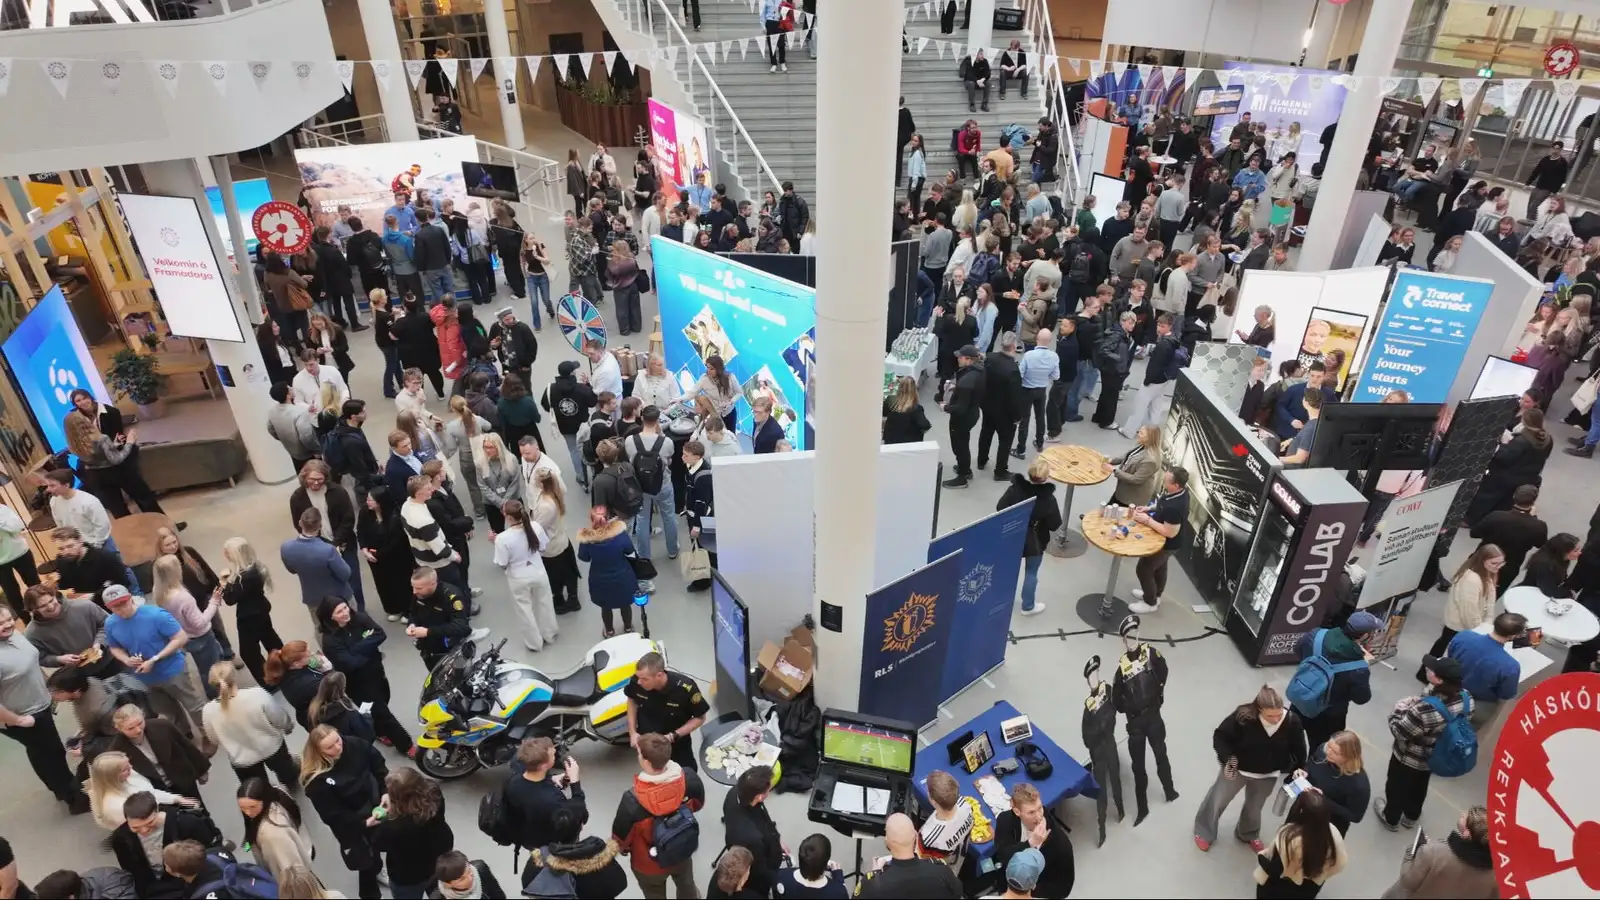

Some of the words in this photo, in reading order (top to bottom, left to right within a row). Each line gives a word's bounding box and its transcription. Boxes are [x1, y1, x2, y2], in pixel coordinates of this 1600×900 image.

[153, 257, 199, 268] Velkomin
[154, 267, 213, 280] Framadaga
[1426, 287, 1465, 302] Travel
[1421, 299, 1473, 313] connect
[1383, 344, 1414, 357] Your
[1375, 357, 1427, 376] journey
[1371, 372, 1408, 385] starts
[1274, 482, 1301, 515] COLLAB
[1386, 531, 1411, 543] Saman
[1286, 521, 1346, 625] COLLAB
[875, 663, 893, 678] RLS
